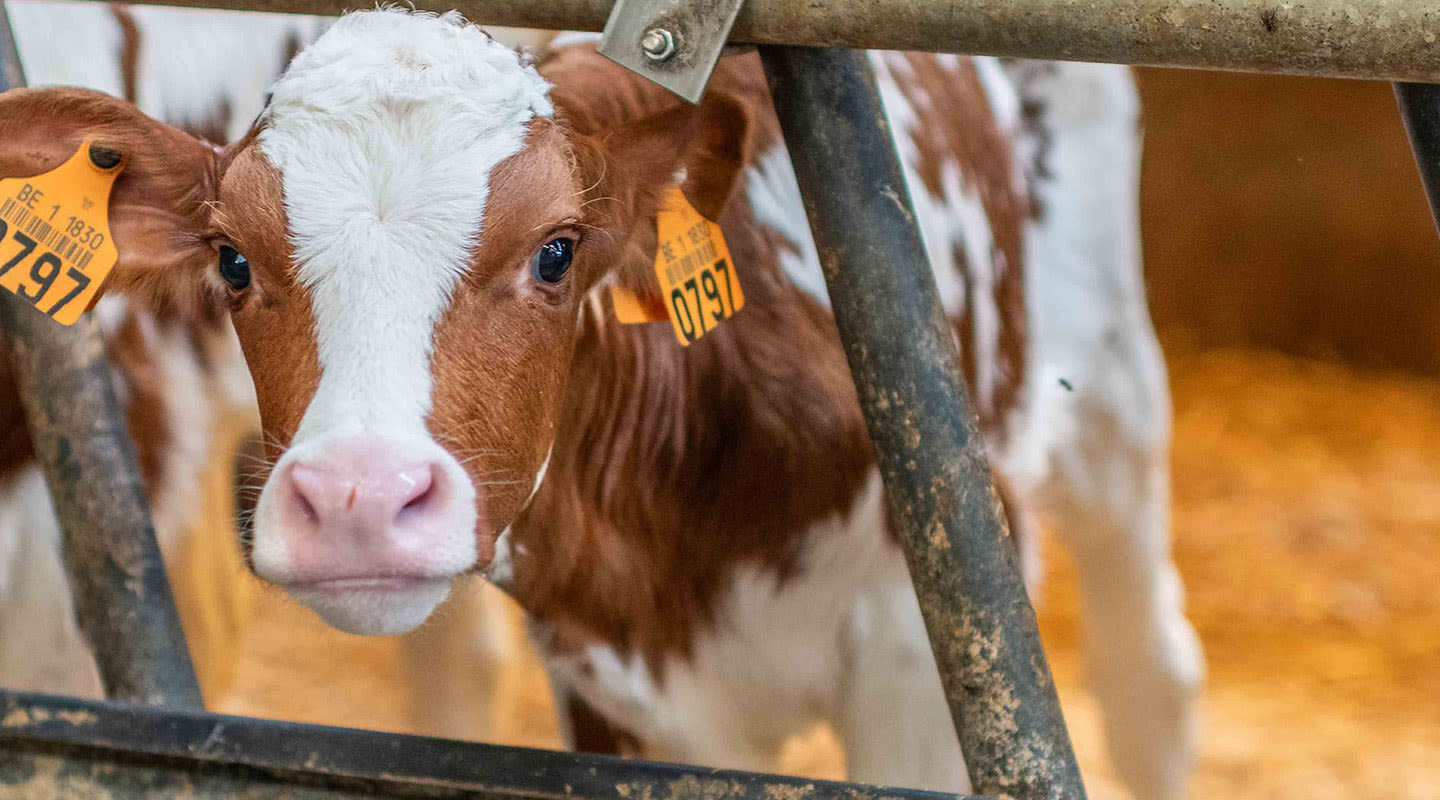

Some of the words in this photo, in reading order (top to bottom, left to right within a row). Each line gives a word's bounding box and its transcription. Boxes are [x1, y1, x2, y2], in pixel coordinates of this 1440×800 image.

[15, 183, 44, 210] BE
[49, 204, 60, 222] 1
[65, 216, 106, 251] 1830
[671, 258, 735, 342] 0797
